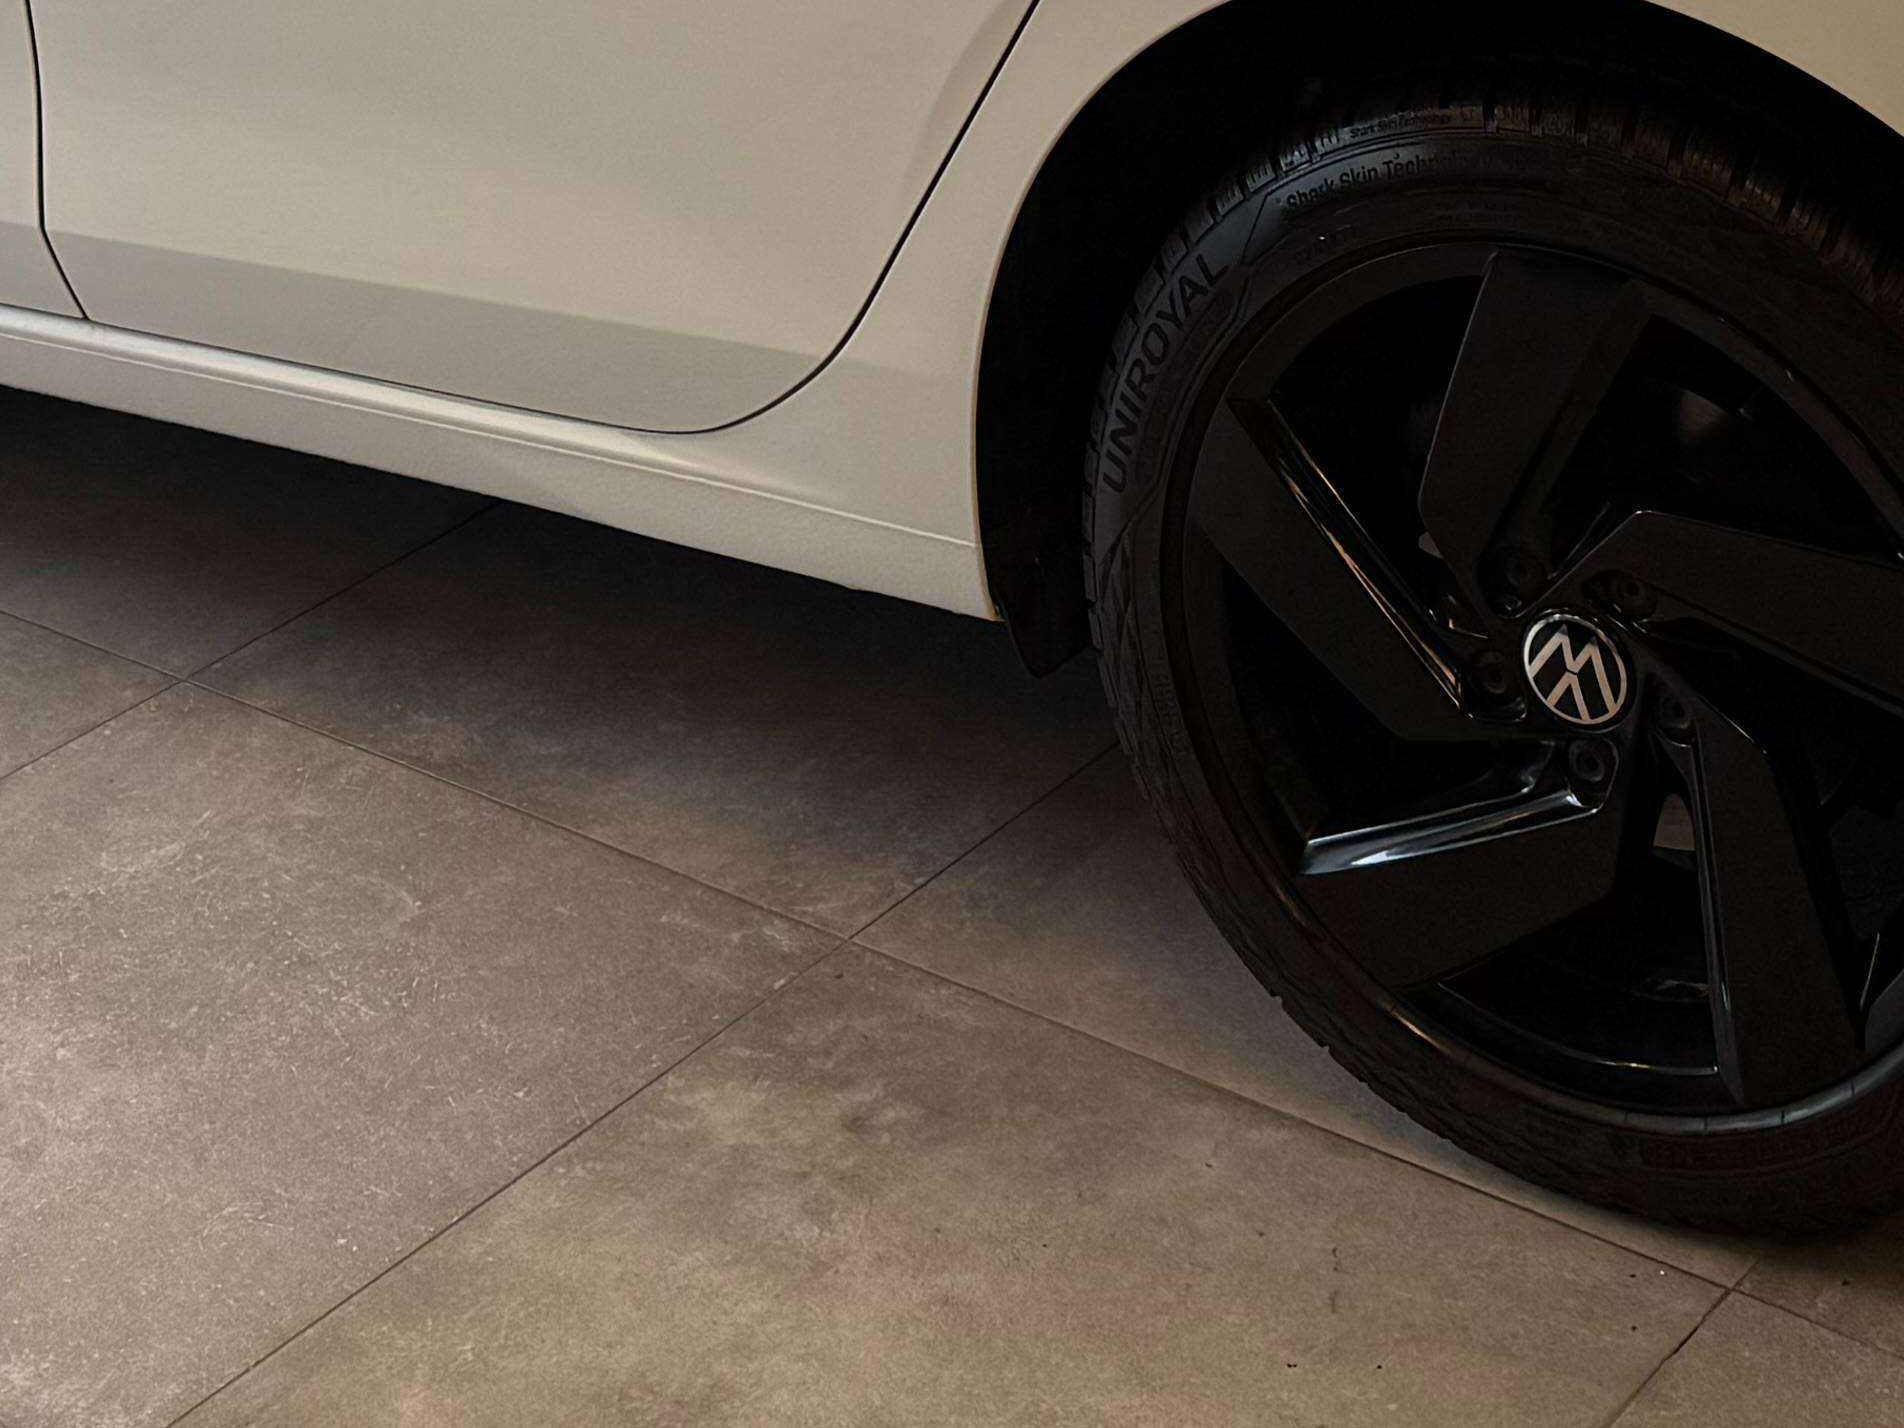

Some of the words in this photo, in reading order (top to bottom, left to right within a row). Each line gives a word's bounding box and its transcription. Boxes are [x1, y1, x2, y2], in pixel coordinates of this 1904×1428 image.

[1287, 178, 1334, 208] Shark
[1340, 165, 1379, 186] Skin
[1103, 254, 1229, 493] UNIROYAL
